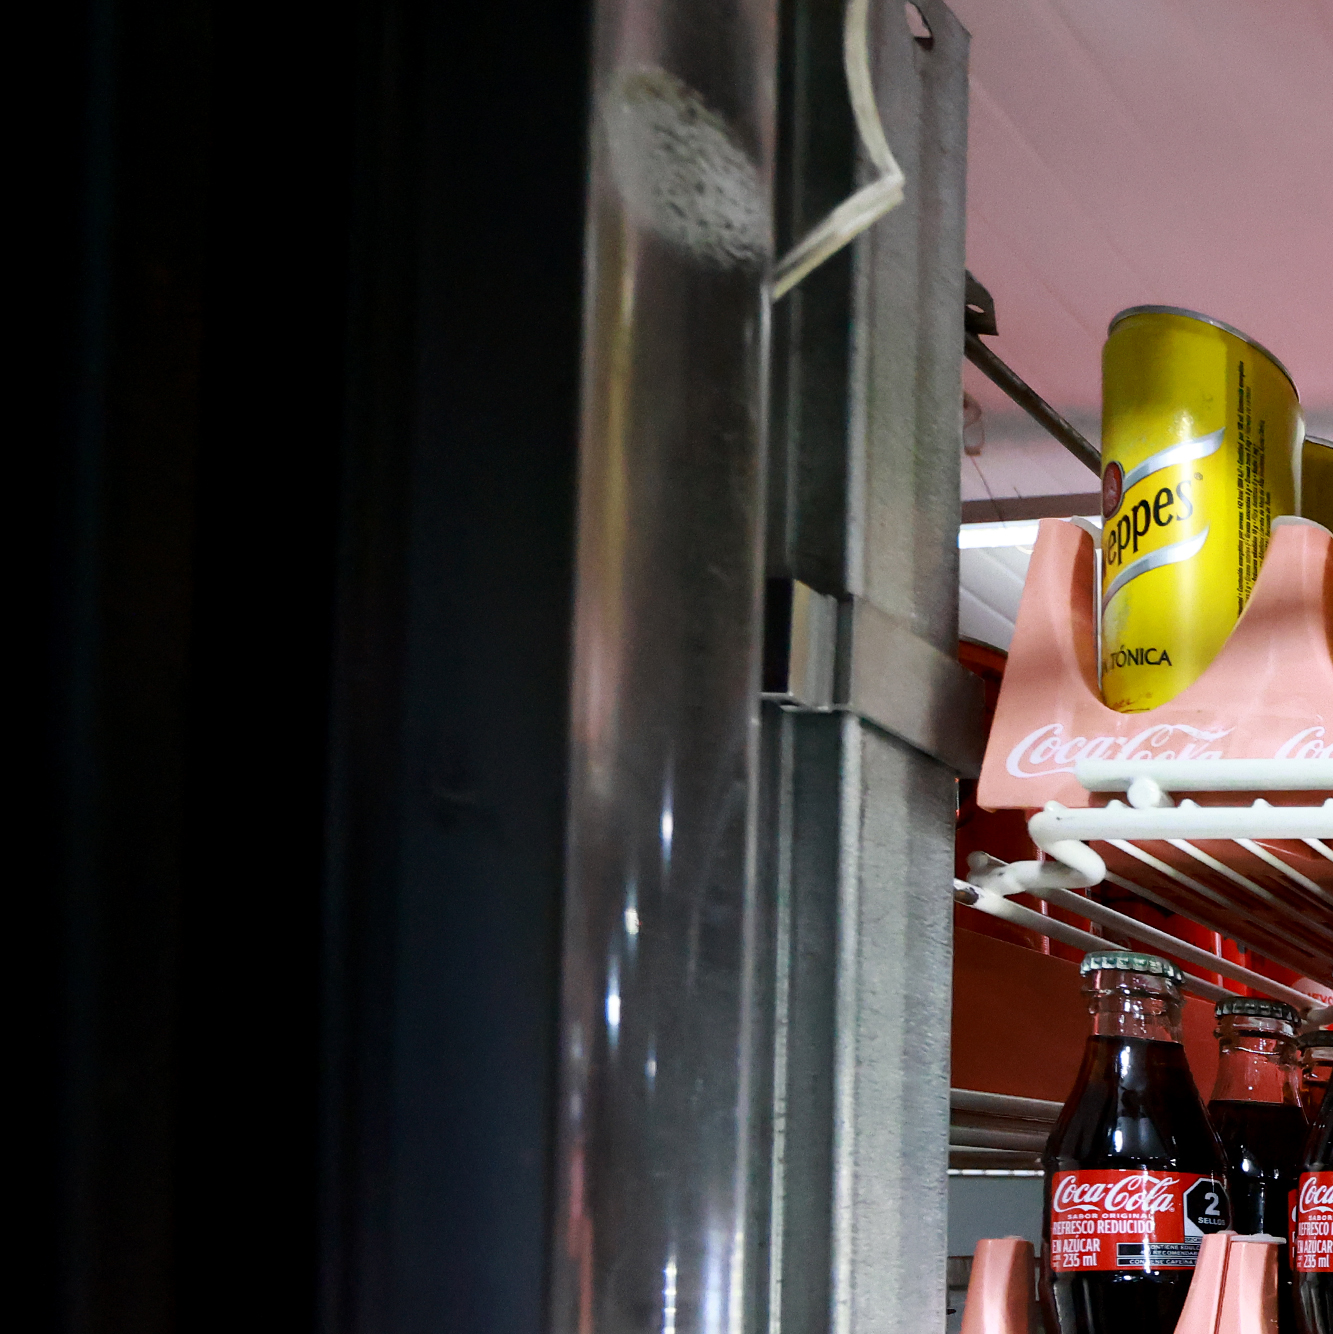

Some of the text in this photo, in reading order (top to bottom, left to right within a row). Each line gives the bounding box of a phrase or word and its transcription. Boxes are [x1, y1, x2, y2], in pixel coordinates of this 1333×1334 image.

[1105, 479, 1194, 568] eppes
[1111, 645, 1172, 670] TÓNICA
[1053, 1175, 1180, 1213] Coca-Cola
[1204, 1192, 1221, 1216] 2
[1053, 1219, 1154, 1234] REFRESCO REDUCIDO
[1197, 1217, 1226, 1226] SELLOS
[1052, 1235, 1101, 1254] EN AZÚCAR
[1303, 1238, 1333, 1254] AZÚCAR
[1062, 1253, 1098, 1268] 235 ml
[1303, 1254, 1330, 1269] 235 ml
